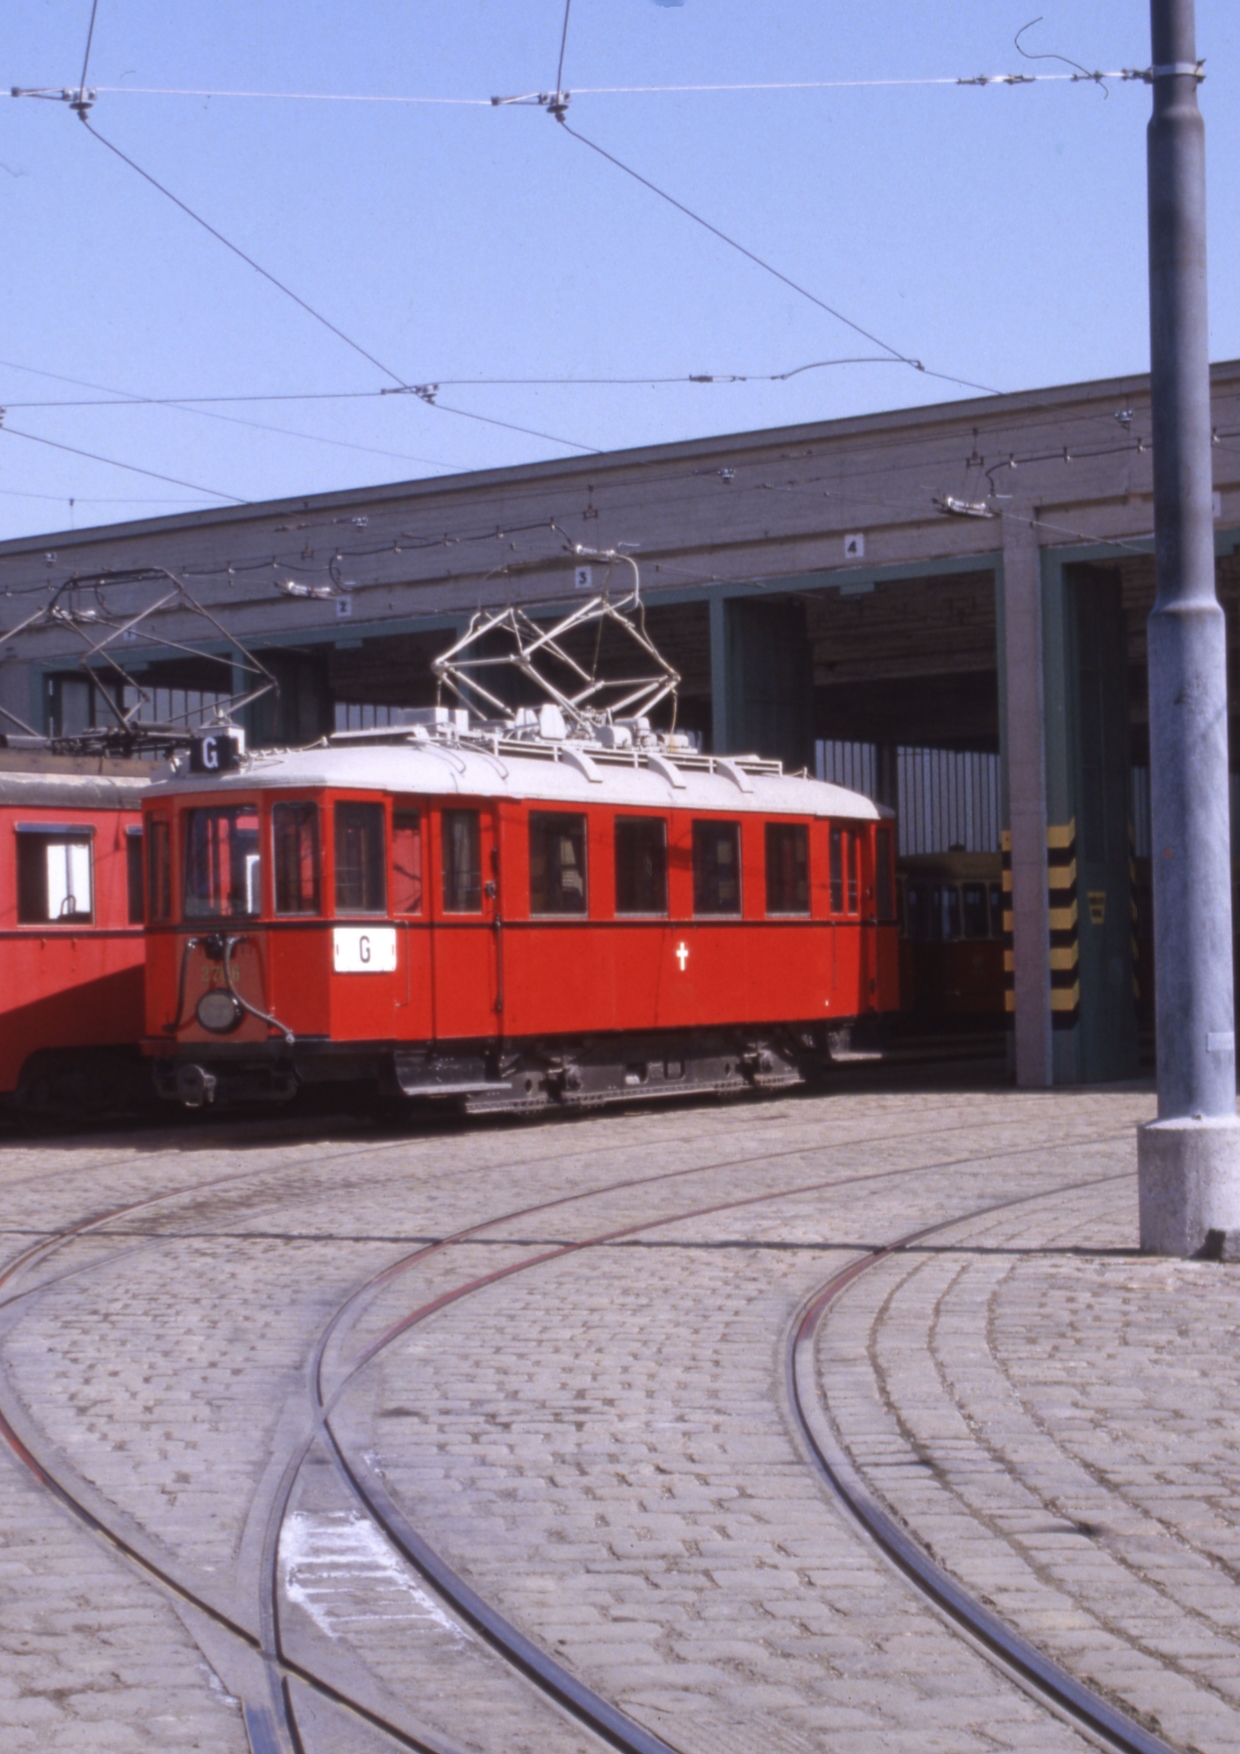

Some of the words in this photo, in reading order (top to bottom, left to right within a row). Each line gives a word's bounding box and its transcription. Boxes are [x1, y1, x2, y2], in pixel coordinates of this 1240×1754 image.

[847, 540, 857, 553] 4
[579, 571, 587, 584] 3
[340, 601, 347, 613] 2
[203, 737, 218, 768] G
[359, 935, 371, 963] G
[201, 964, 240, 983] 276
